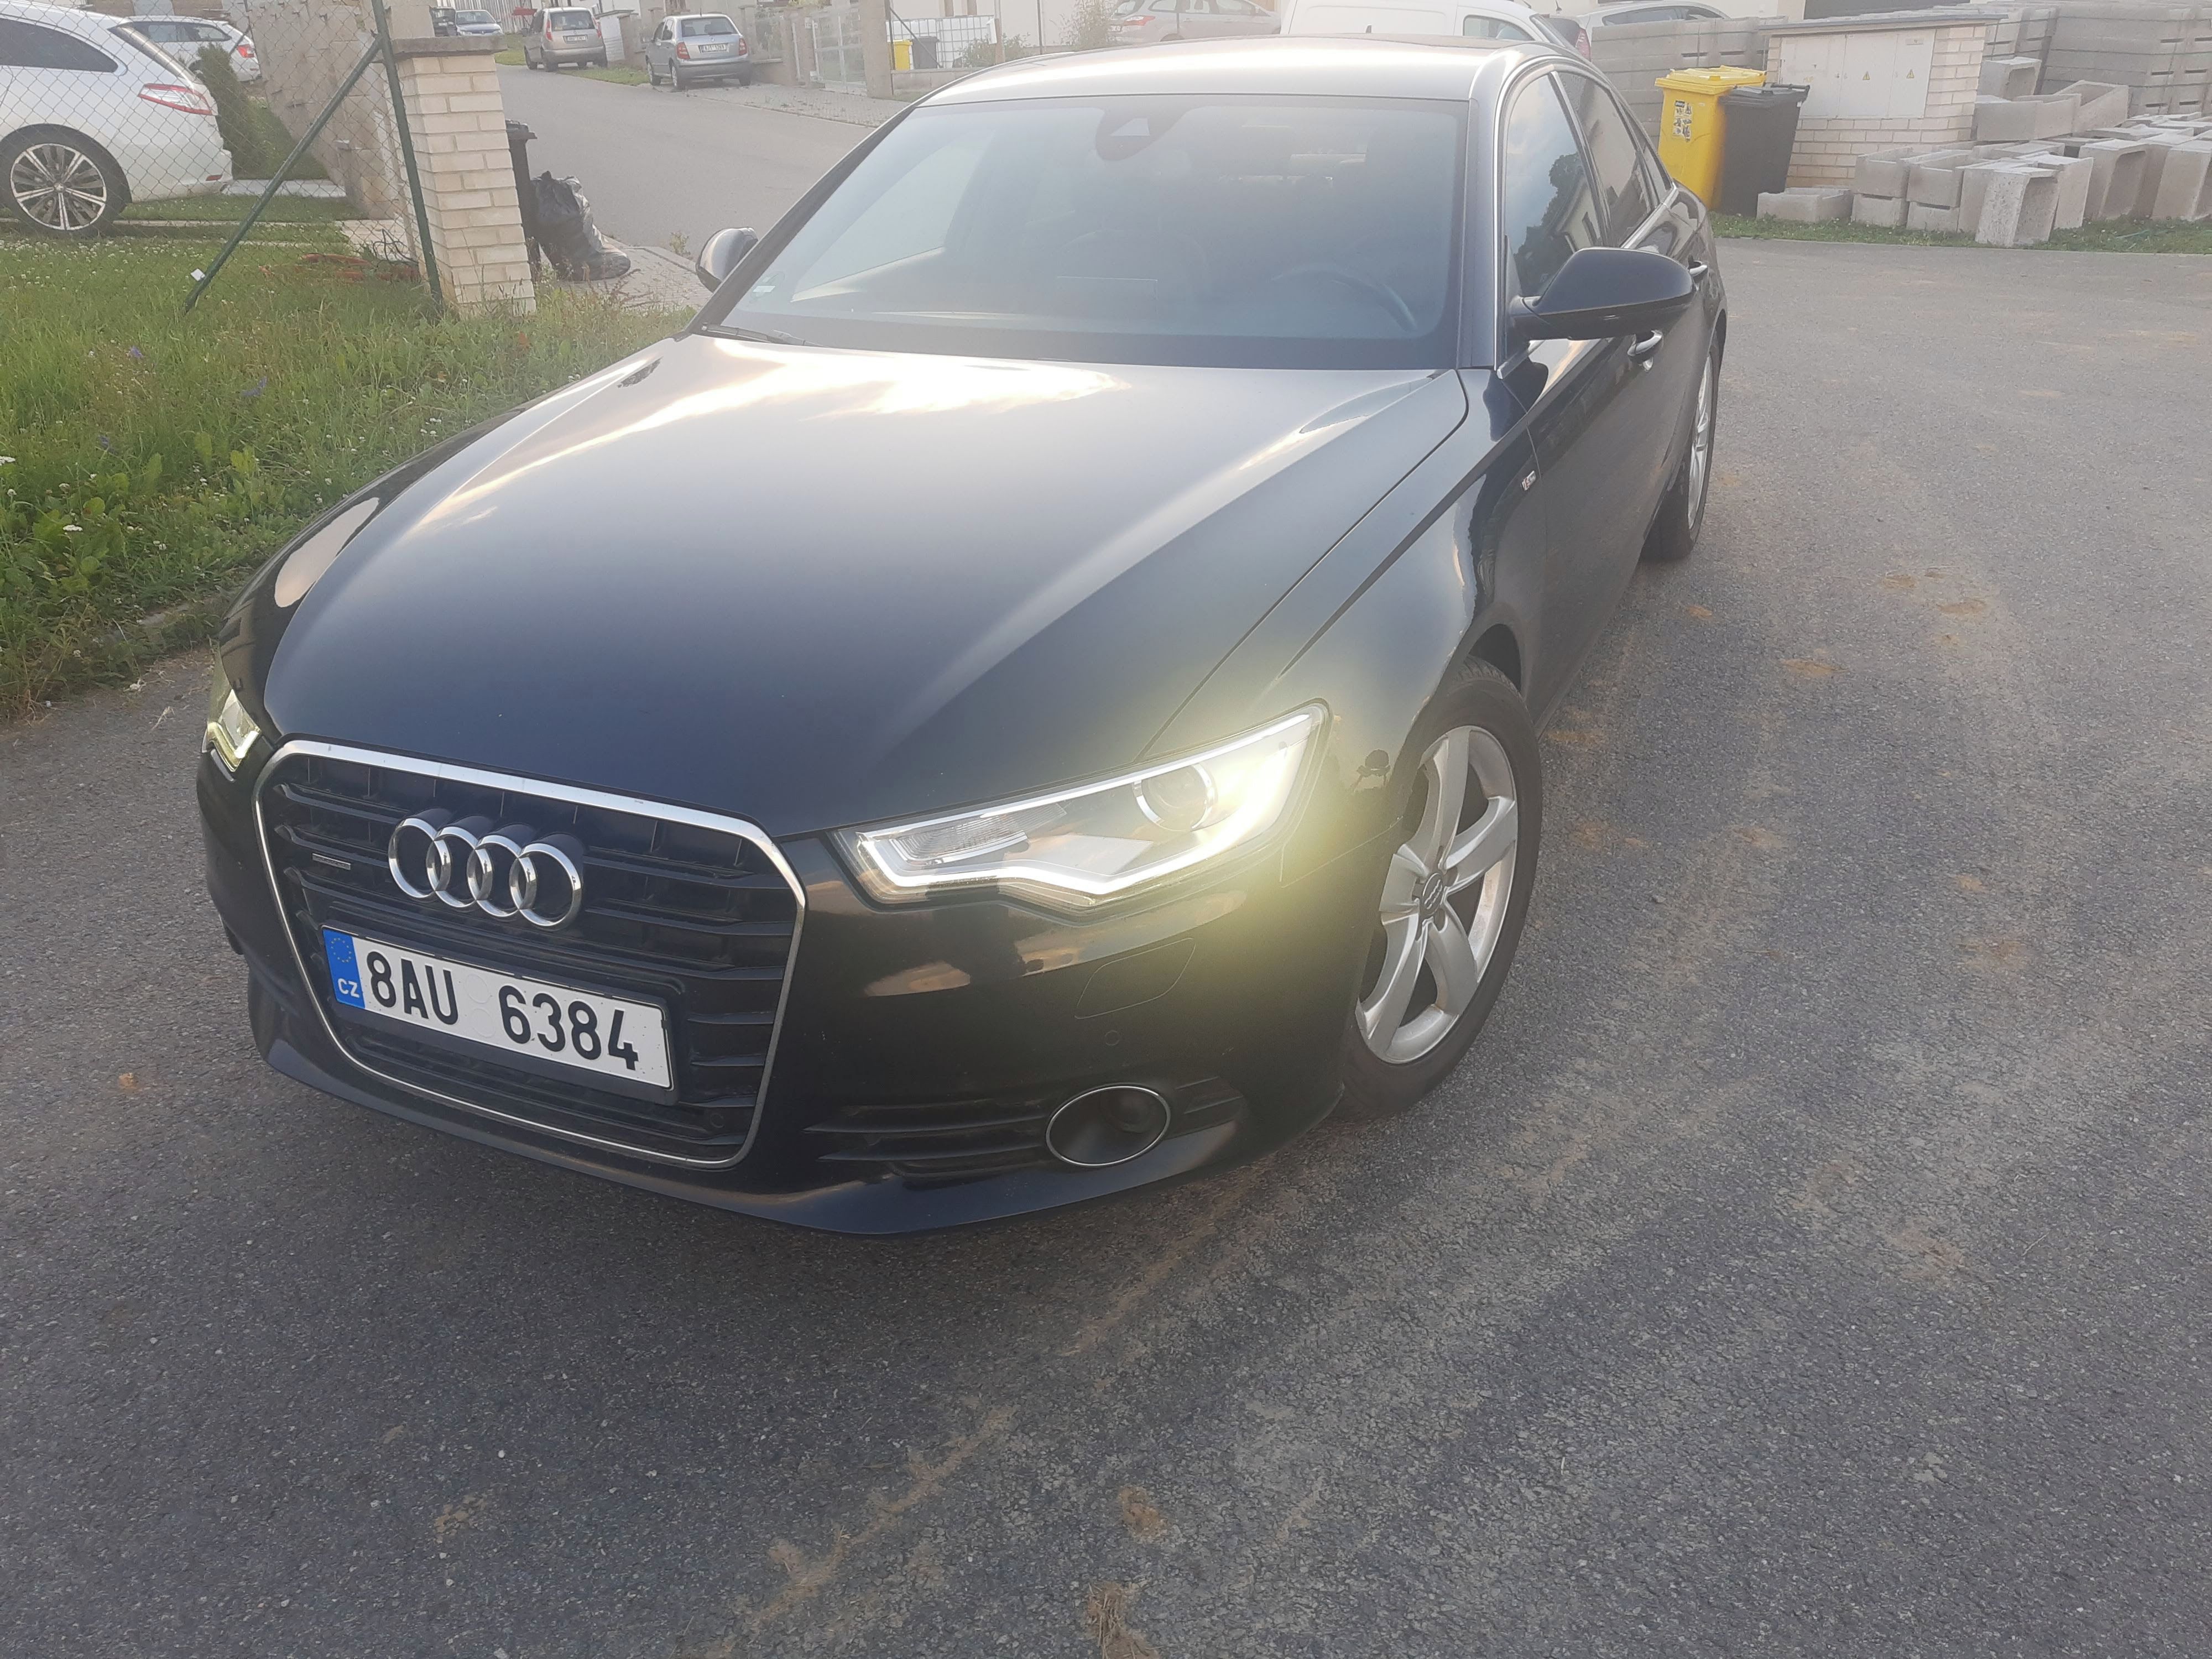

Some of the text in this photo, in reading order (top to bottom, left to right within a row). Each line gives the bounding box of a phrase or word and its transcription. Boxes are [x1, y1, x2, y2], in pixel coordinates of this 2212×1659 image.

[337, 978, 360, 998] CZ
[366, 951, 639, 1071] 8AU 6384
